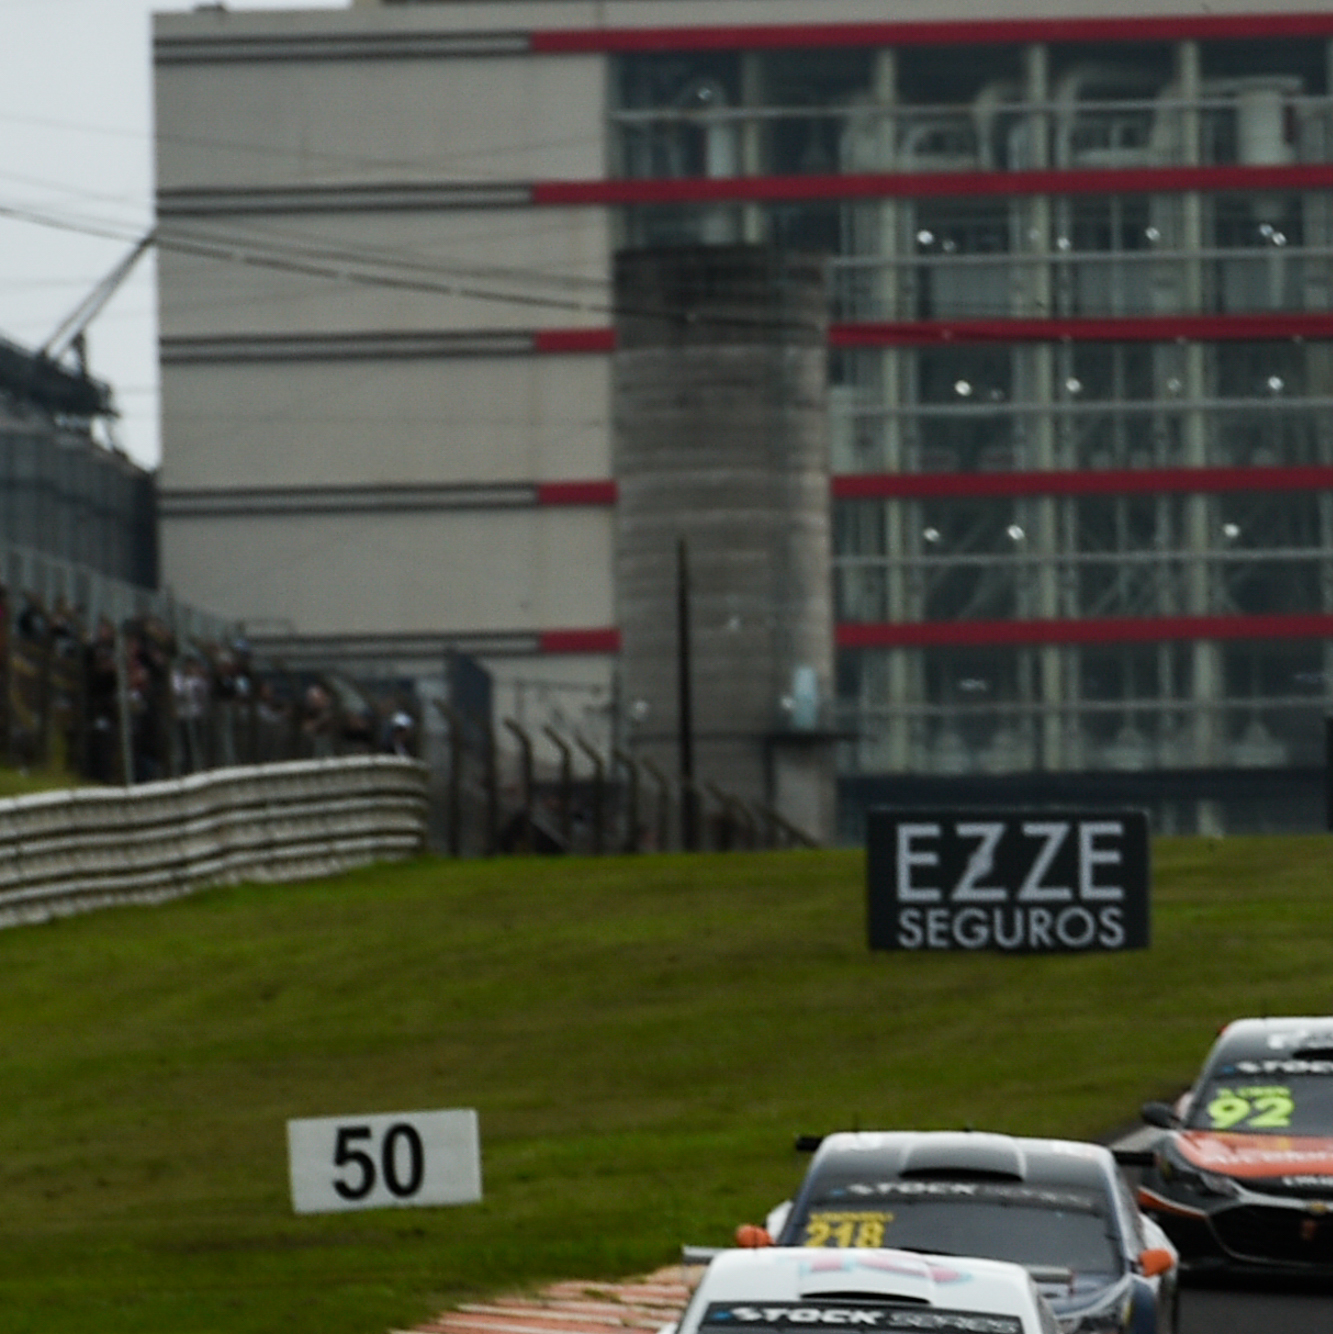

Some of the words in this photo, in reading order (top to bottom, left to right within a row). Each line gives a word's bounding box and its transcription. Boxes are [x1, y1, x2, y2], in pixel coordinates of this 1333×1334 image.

[897, 823, 1124, 900] EZZE
[900, 906, 1125, 948] SEGUROS
[1207, 1096, 1295, 1129] 92
[333, 1123, 424, 1200] 50
[805, 1220, 886, 1248] 218
[731, 1306, 885, 1325] STOCK
